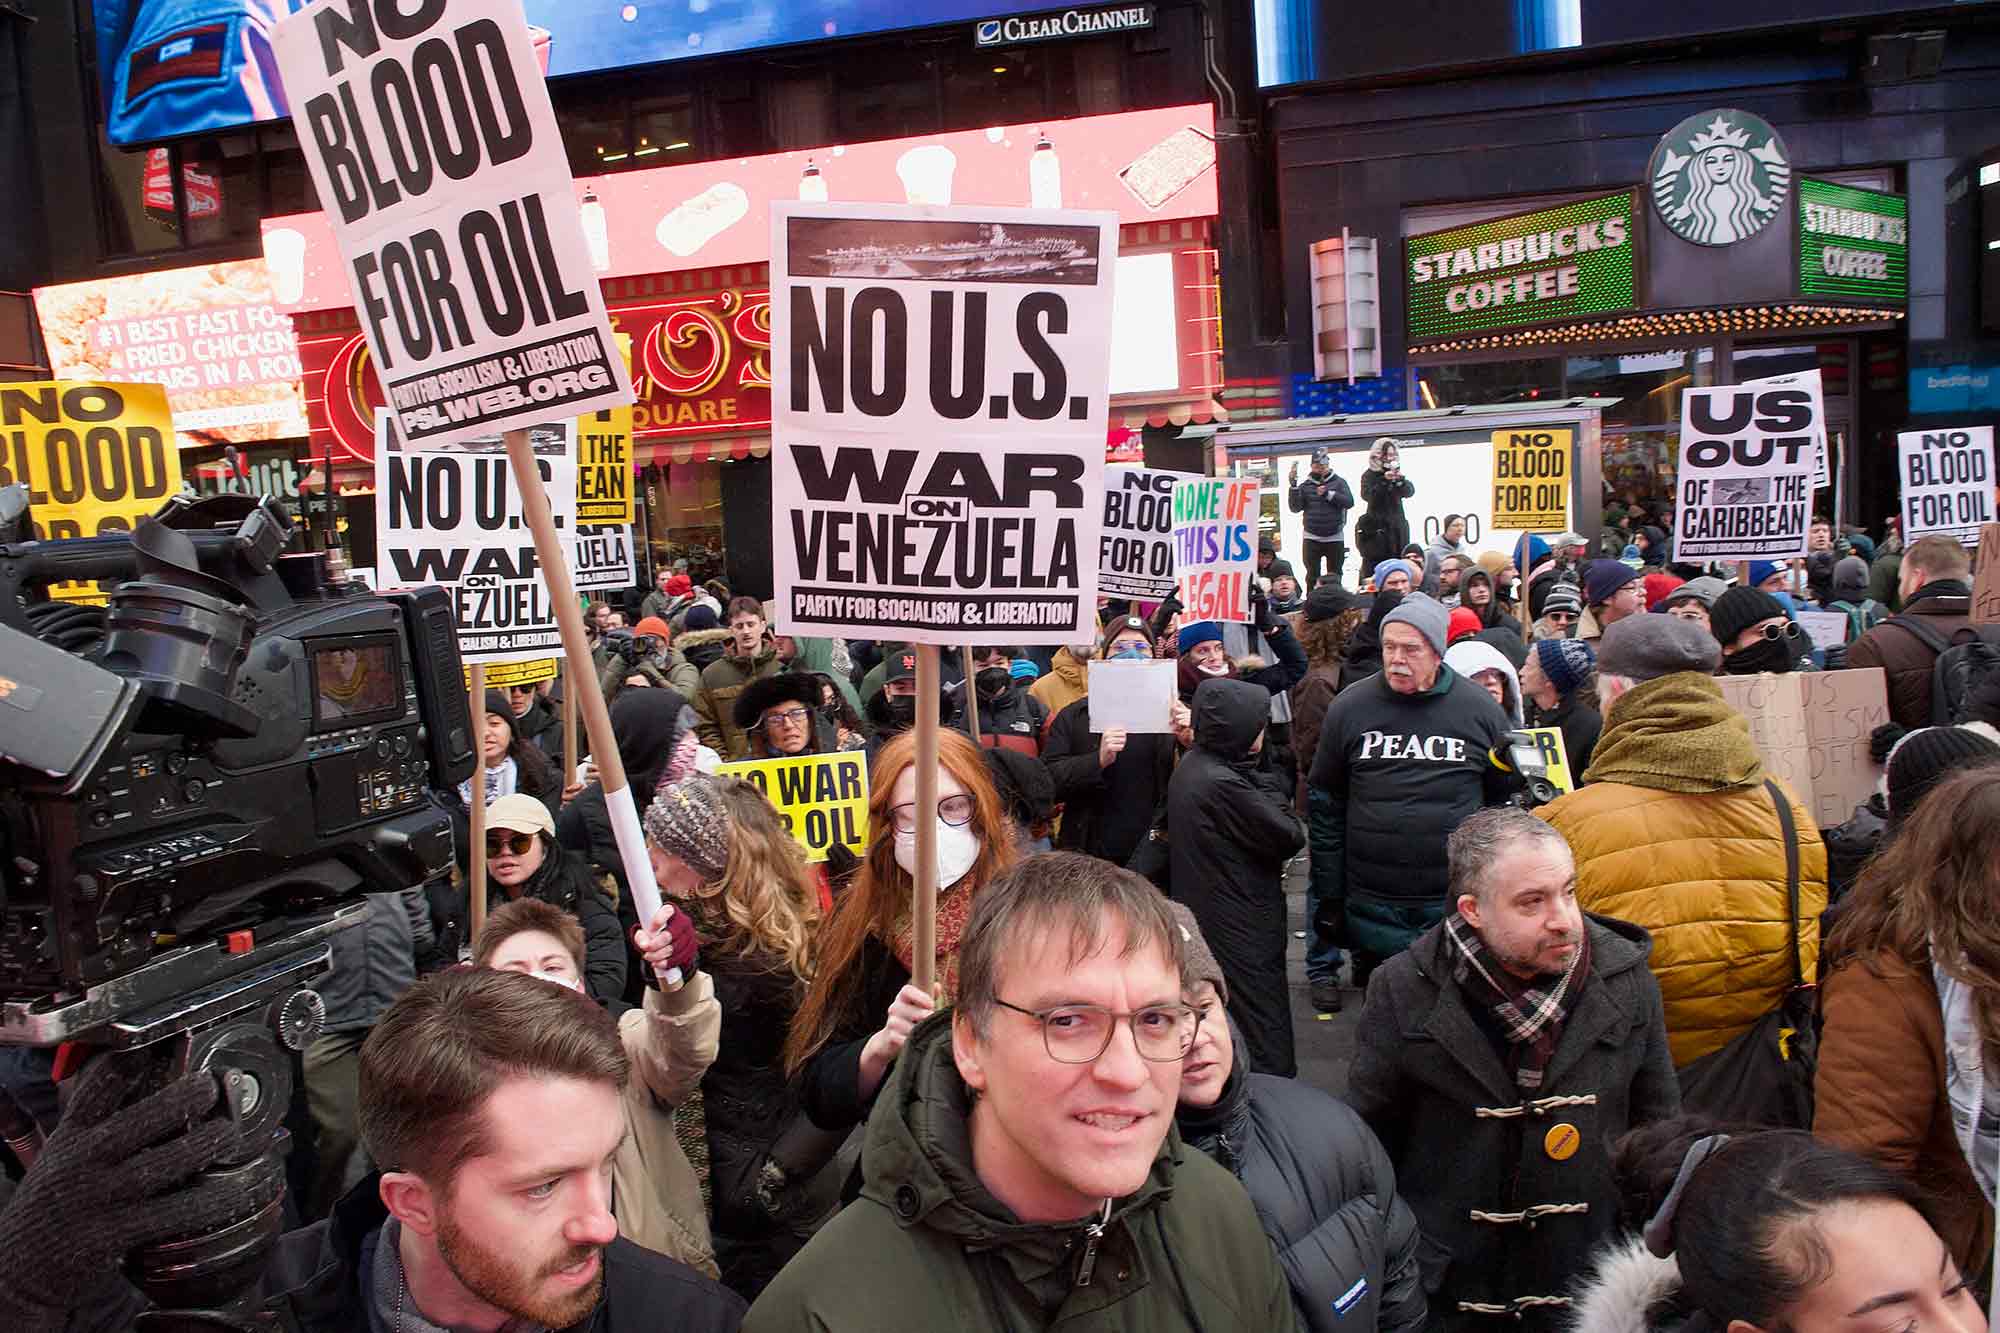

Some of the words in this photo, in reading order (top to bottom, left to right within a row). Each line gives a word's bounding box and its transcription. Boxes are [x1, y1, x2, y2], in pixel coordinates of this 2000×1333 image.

[314, 0, 446, 77] NO
[304, 18, 532, 224] BLOOD
[1413, 217, 1626, 283] STARBUCKS
[353, 228, 475, 369] FOR
[458, 193, 589, 337] OIL
[1445, 265, 1578, 313] COFFEE
[127, 317, 180, 343] BEST
[185, 311, 239, 336] FAST
[126, 342, 187, 368] FRIED
[192, 331, 300, 360] CHICKEN
[504, 356, 525, 381] &
[520, 333, 603, 379] LIBERATION
[791, 286, 907, 417] NO
[929, 290, 1089, 420] U.S.
[203, 363, 231, 384] IN
[237, 359, 254, 383] A
[1, 386, 124, 425] NO
[402, 364, 611, 435] PSLWEB.ORG
[632, 398, 737, 430] QUARE
[1690, 390, 1813, 435] US
[587, 434, 624, 463] THE
[1510, 433, 1553, 447] NO
[1686, 436, 1811, 468] OUT
[1922, 431, 1970, 450] NO
[790, 445, 1085, 508] WAR
[1497, 449, 1564, 478] BLOOD
[1908, 449, 1986, 487] BLOOD
[388, 456, 462, 531] NO
[910, 500, 960, 516] ON
[1226, 483, 1257, 521] OF
[1495, 485, 1531, 511] FOR
[1537, 484, 1564, 511] OIL
[1684, 480, 1709, 505] OF
[1774, 475, 1807, 502] THE
[1908, 493, 1953, 527] FOR
[1957, 491, 1990, 523] OIL
[1104, 491, 1173, 534] BLOO
[1682, 503, 1804, 539] CARIBBEAN
[790, 509, 1079, 589] VENEZUELA
[1099, 535, 1146, 574] FOR
[1151, 541, 1173, 577] OI
[1175, 526, 1219, 567] THIS
[1223, 525, 1251, 562] IS
[466, 577, 497, 588] ON
[795, 594, 845, 617] PARTY
[846, 597, 877, 618] FOR
[877, 598, 960, 625] SOCIALISM
[962, 602, 983, 625] &
[985, 602, 1073, 625] LIBERATION
[498, 635, 512, 649] &
[1360, 731, 1466, 761] PEACE
[777, 762, 862, 806] WAR
[806, 807, 861, 849] OIL
